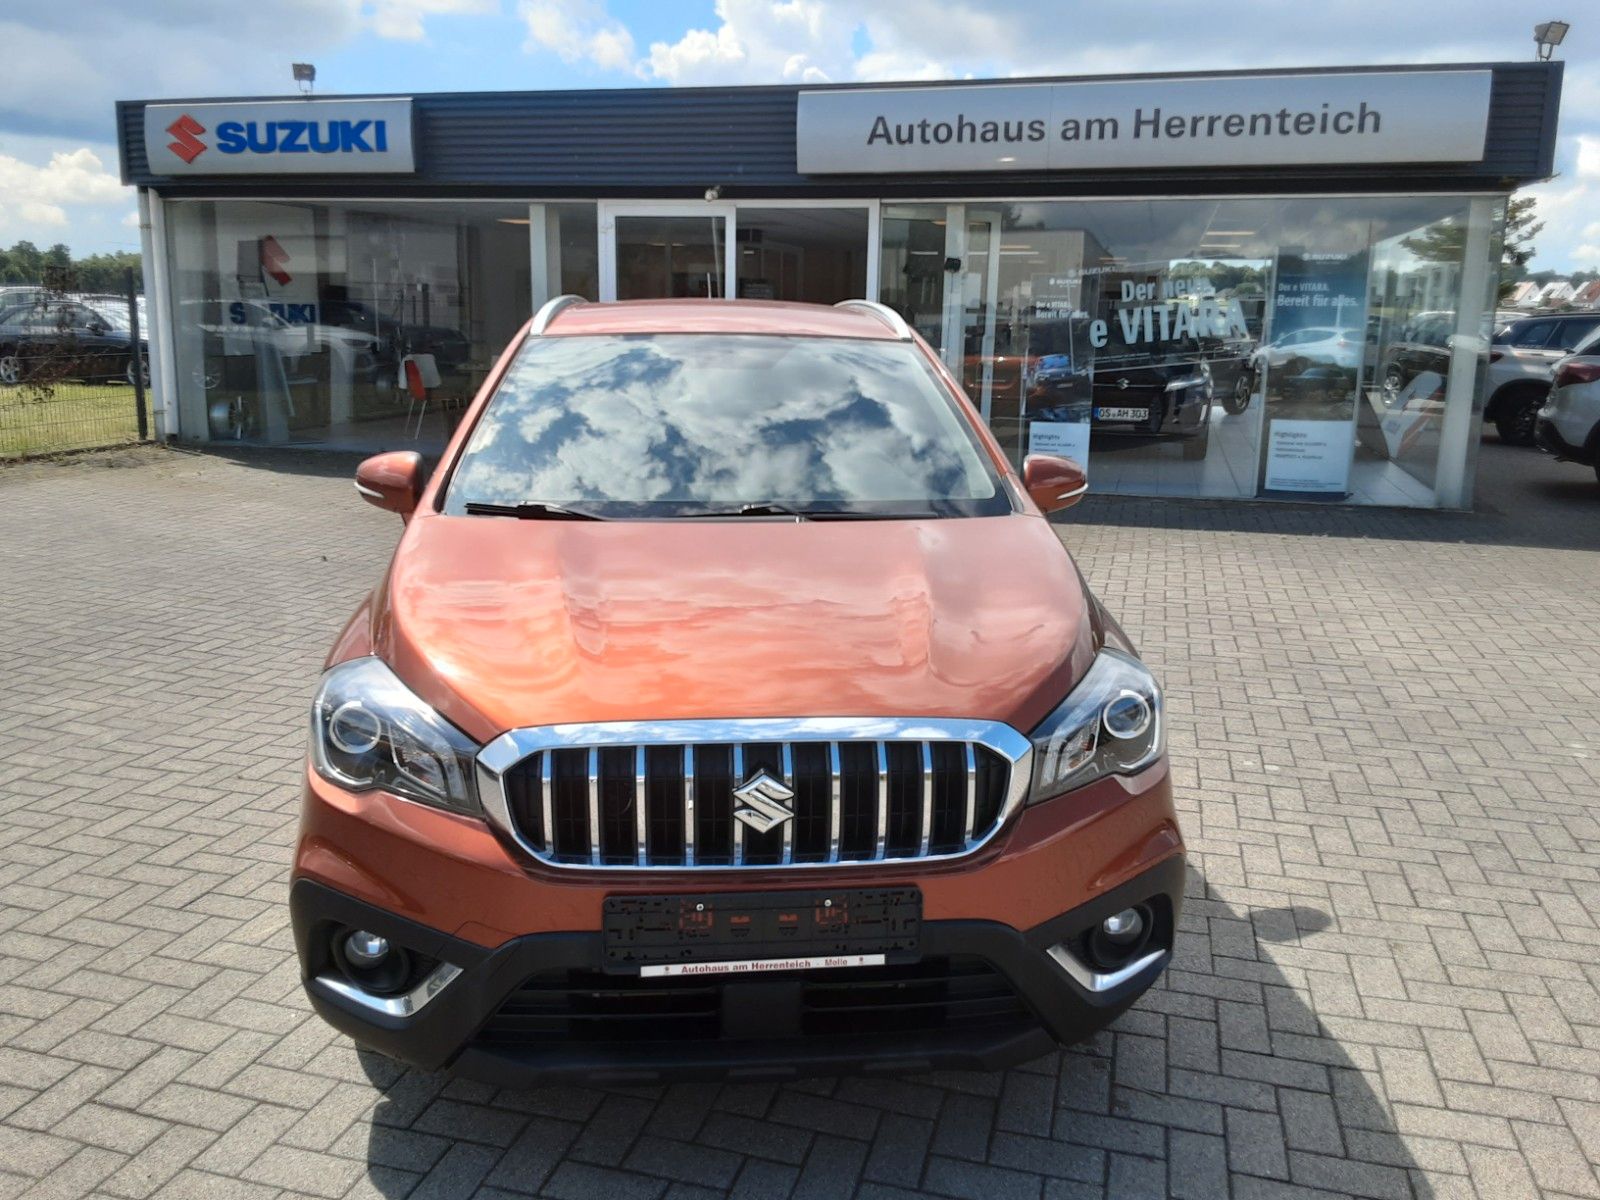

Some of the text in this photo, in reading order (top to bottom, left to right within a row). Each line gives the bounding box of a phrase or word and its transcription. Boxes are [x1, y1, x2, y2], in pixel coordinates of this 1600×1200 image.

[216, 119, 389, 154] SUZUKI
[866, 102, 1382, 146] Autohaus am Herrenteich
[1121, 279, 1156, 303] Der
[1089, 298, 1250, 348] e VITARA
[1099, 408, 1111, 418] OS
[681, 964, 730, 974] Autohaus
[732, 963, 748, 971] am
[751, 959, 811, 970] Herrenteich
